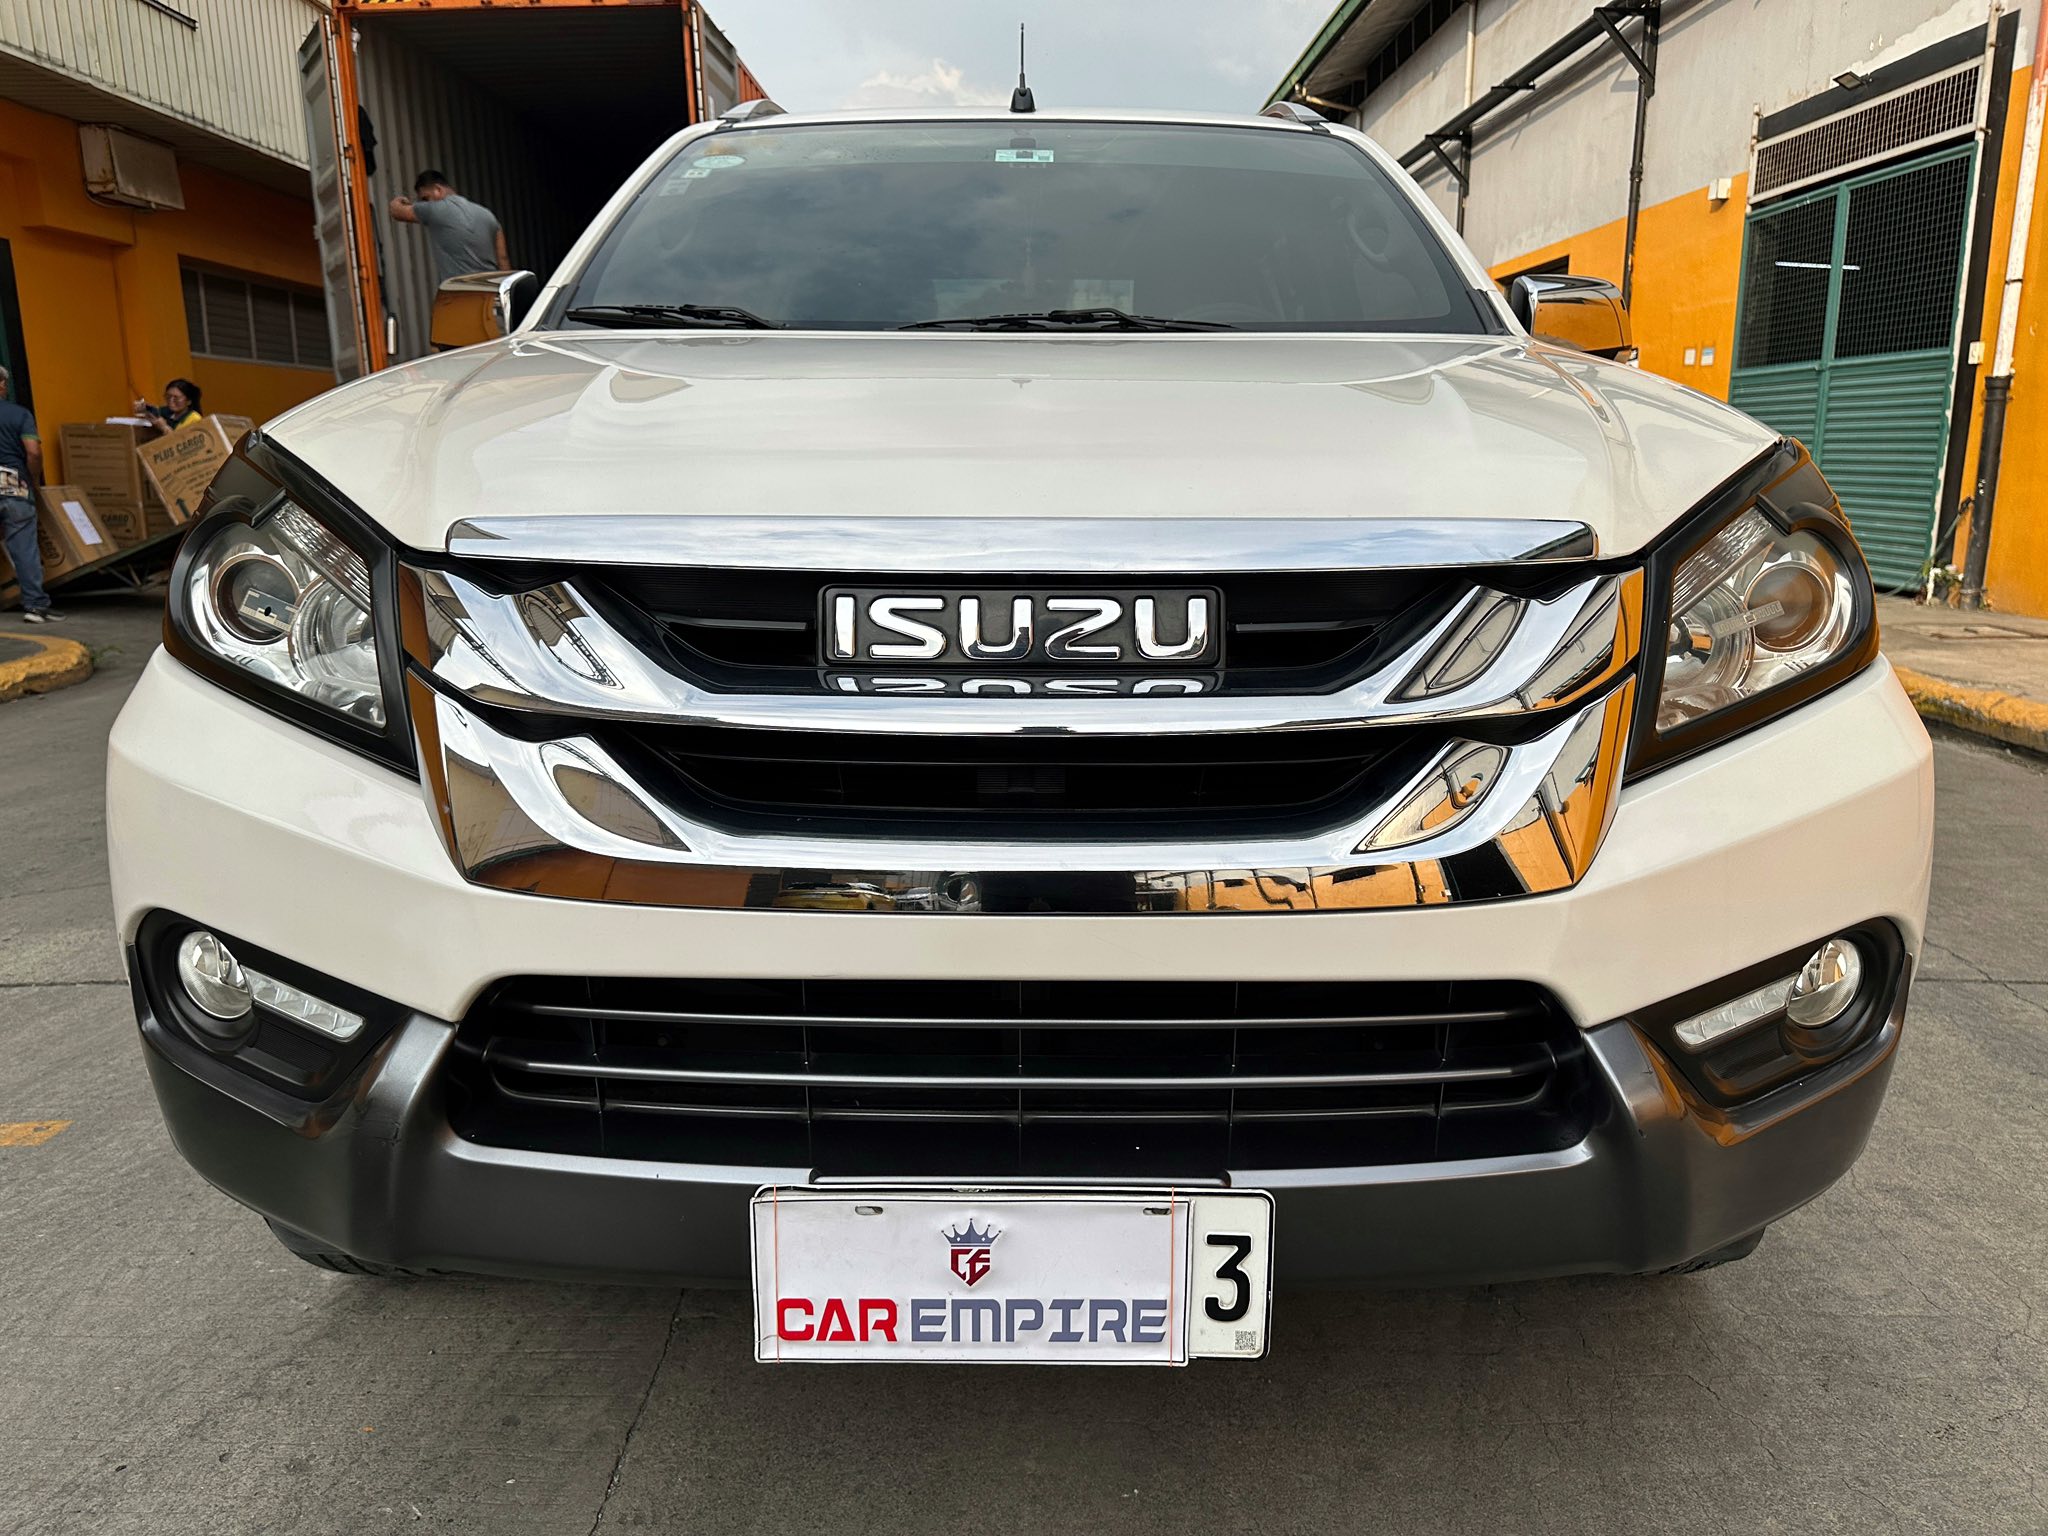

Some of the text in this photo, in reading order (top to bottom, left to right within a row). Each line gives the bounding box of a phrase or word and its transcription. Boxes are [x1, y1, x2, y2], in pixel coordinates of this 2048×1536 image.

[153, 433, 206, 465] PLUS CARGO
[834, 595, 1209, 660] ISUZU
[1204, 1234, 1252, 1322] 3
[777, 1298, 1168, 1344] CAR EMPIRE
